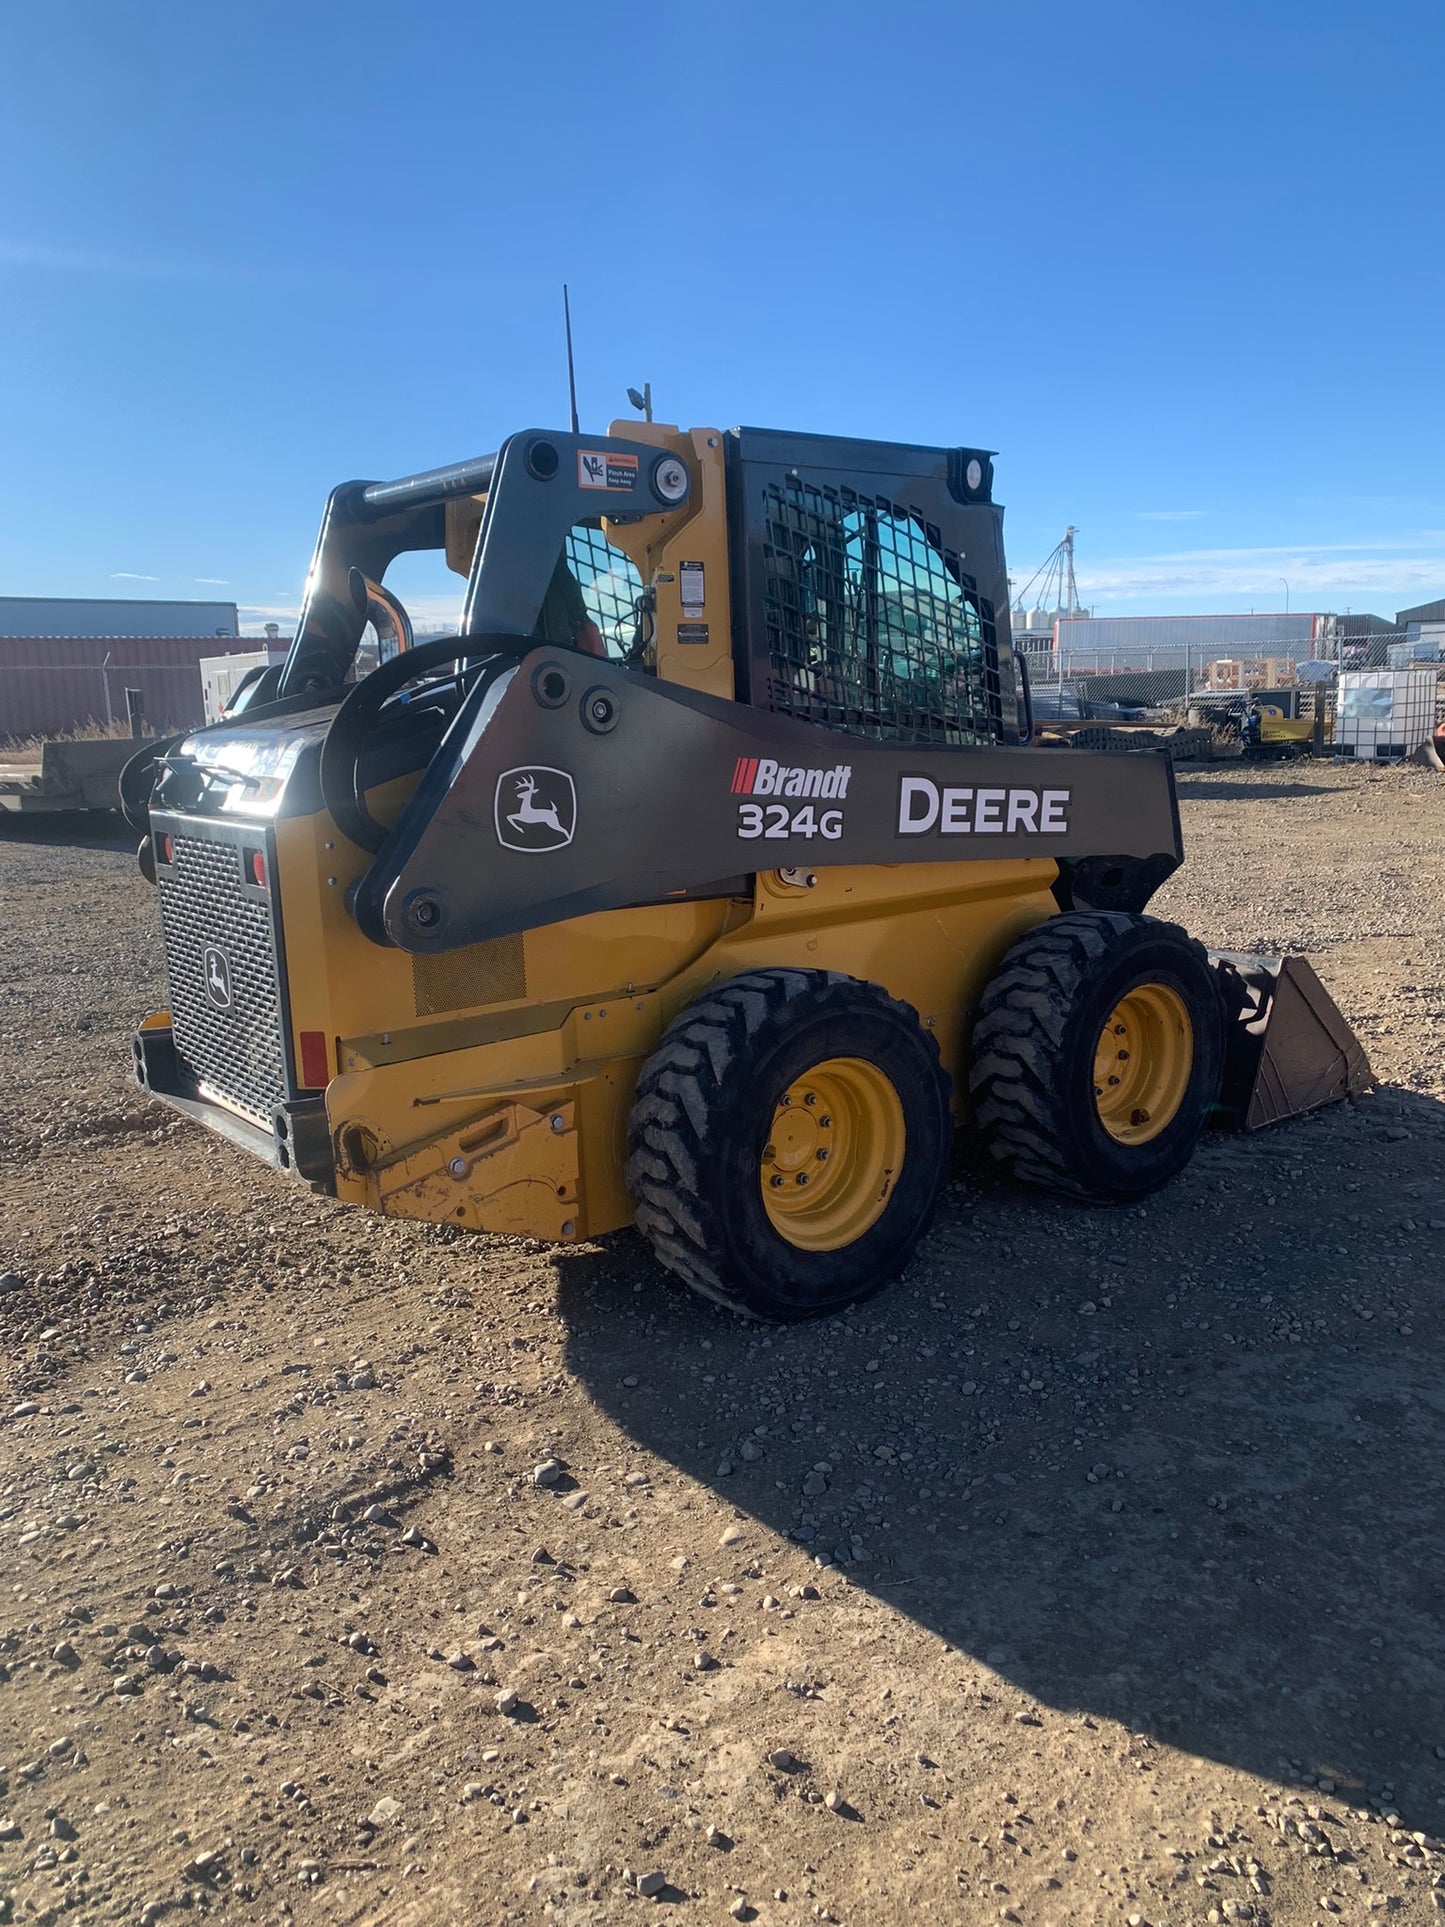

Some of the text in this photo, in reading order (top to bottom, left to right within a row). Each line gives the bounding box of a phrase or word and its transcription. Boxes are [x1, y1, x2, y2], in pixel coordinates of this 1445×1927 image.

[753, 759, 851, 799] Brandt
[738, 804, 843, 839] 324G
[899, 777, 1070, 833] DEERE
